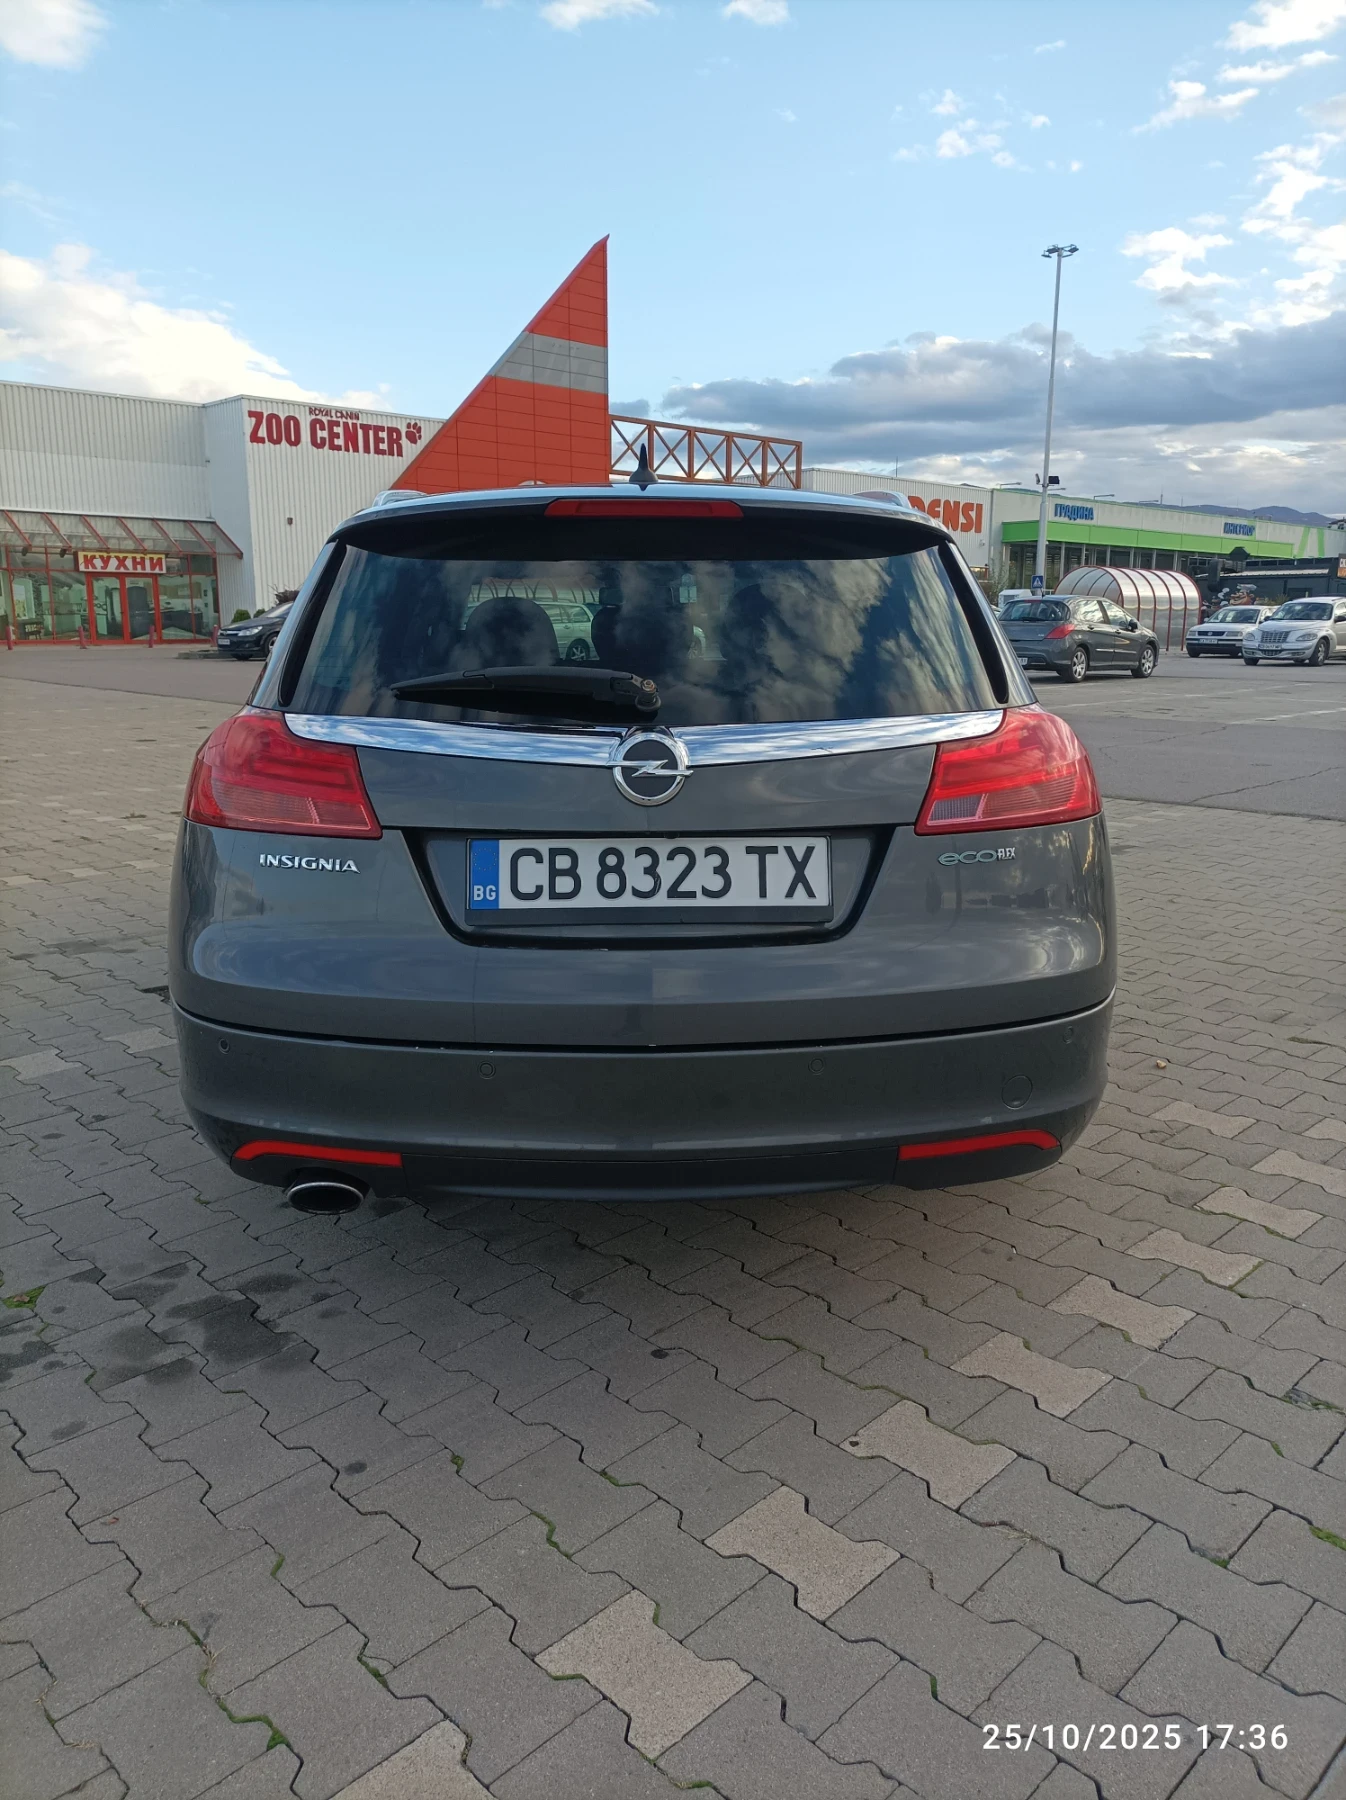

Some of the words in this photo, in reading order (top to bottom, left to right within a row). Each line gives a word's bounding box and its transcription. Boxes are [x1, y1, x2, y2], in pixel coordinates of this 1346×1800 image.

[309, 406, 333, 419] ROYAL
[335, 410, 360, 421] CANIN
[247, 410, 301, 447] ZOO
[309, 418, 404, 458] CENTER
[1054, 503, 1094, 522] ГРАДИНА
[83, 554, 164, 572] КУХНИ
[259, 853, 361, 874] INSIGNIA
[509, 847, 582, 901] CB
[596, 846, 733, 900] 8323
[745, 845, 817, 899] TX
[473, 884, 497, 901] BG
